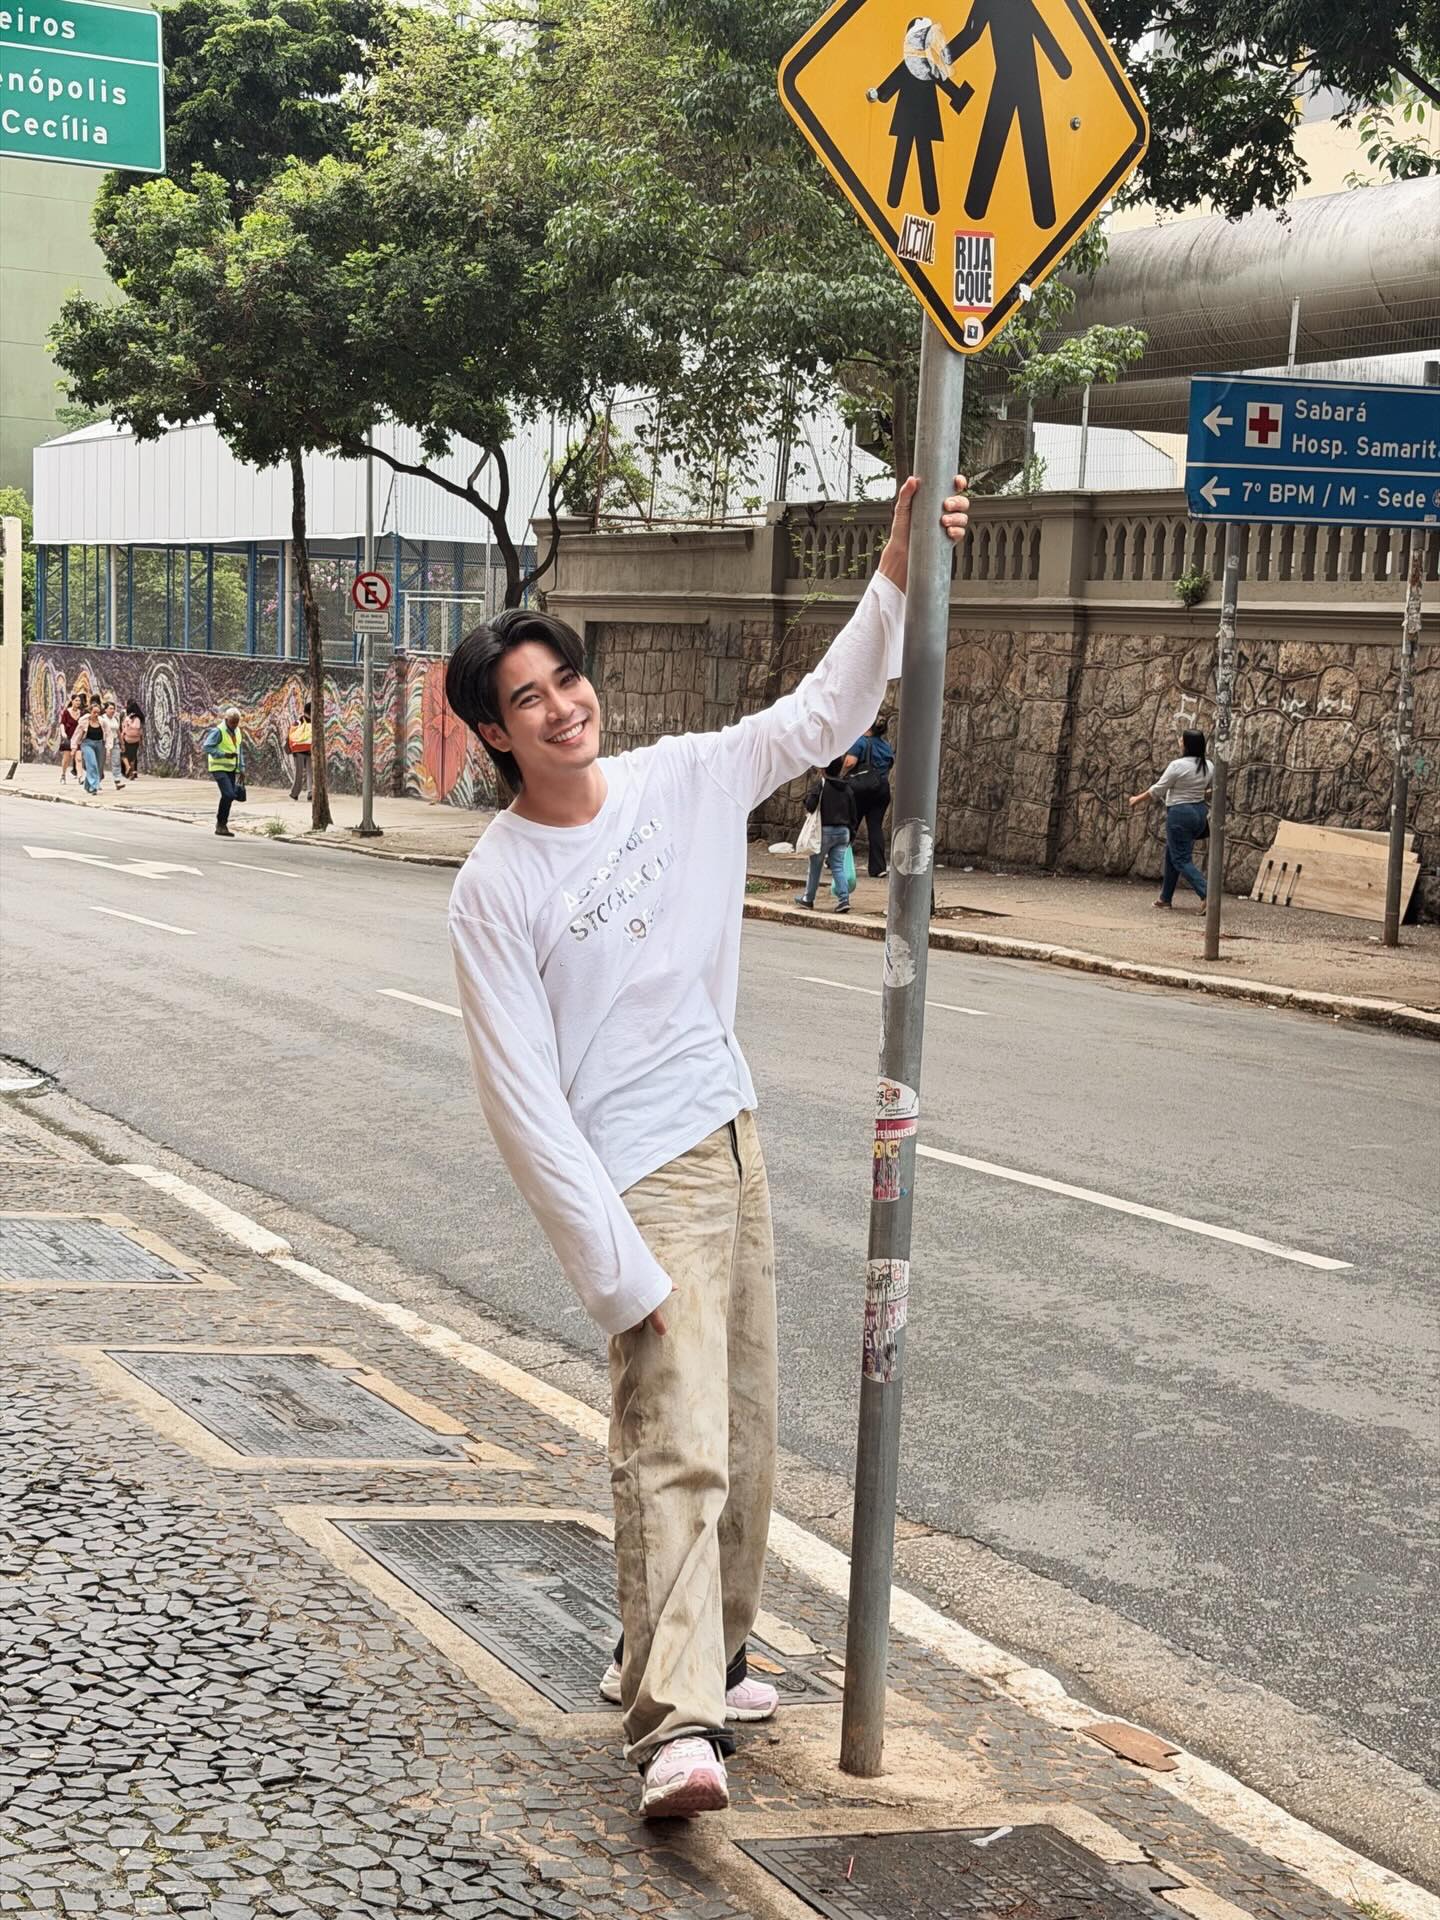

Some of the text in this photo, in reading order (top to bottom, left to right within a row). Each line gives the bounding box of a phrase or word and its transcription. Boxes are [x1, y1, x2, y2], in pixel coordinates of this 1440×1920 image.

[0, 68, 127, 106] nópolis
[1, 109, 108, 145] Cecília
[955, 236, 992, 271] RIJA
[955, 270, 992, 306] CQUE
[1294, 399, 1367, 422] Sabará
[1291, 433, 1440, 460] Hosp. Samarit
[1269, 483, 1315, 505] BPM
[1339, 486, 1356, 506] M
[1377, 487, 1427, 508] Sede
[365, 582, 378, 603] E
